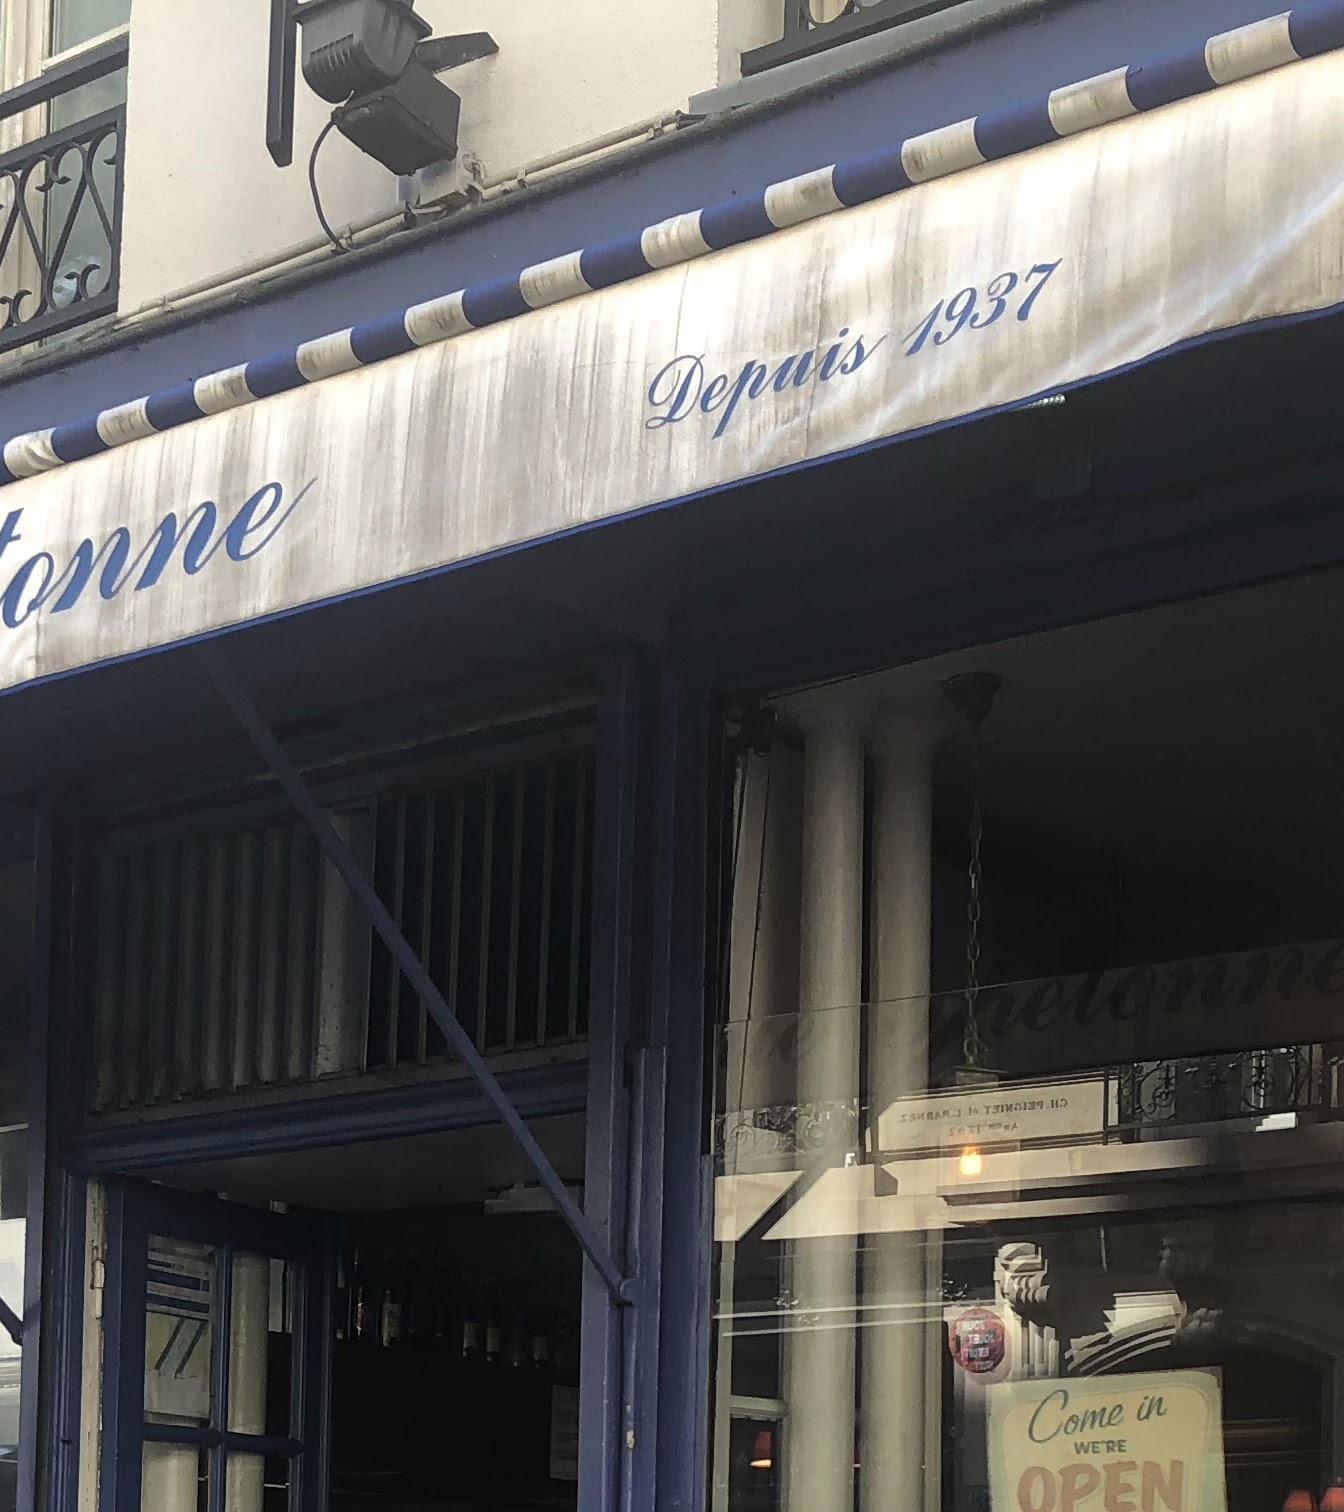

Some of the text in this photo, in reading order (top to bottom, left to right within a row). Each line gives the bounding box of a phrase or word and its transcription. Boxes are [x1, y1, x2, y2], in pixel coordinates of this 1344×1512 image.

[645, 258, 1063, 439] Depuis 1937
[1028, 1388, 1168, 1445] Come in
[1073, 1436, 1128, 1456] WE'RE
